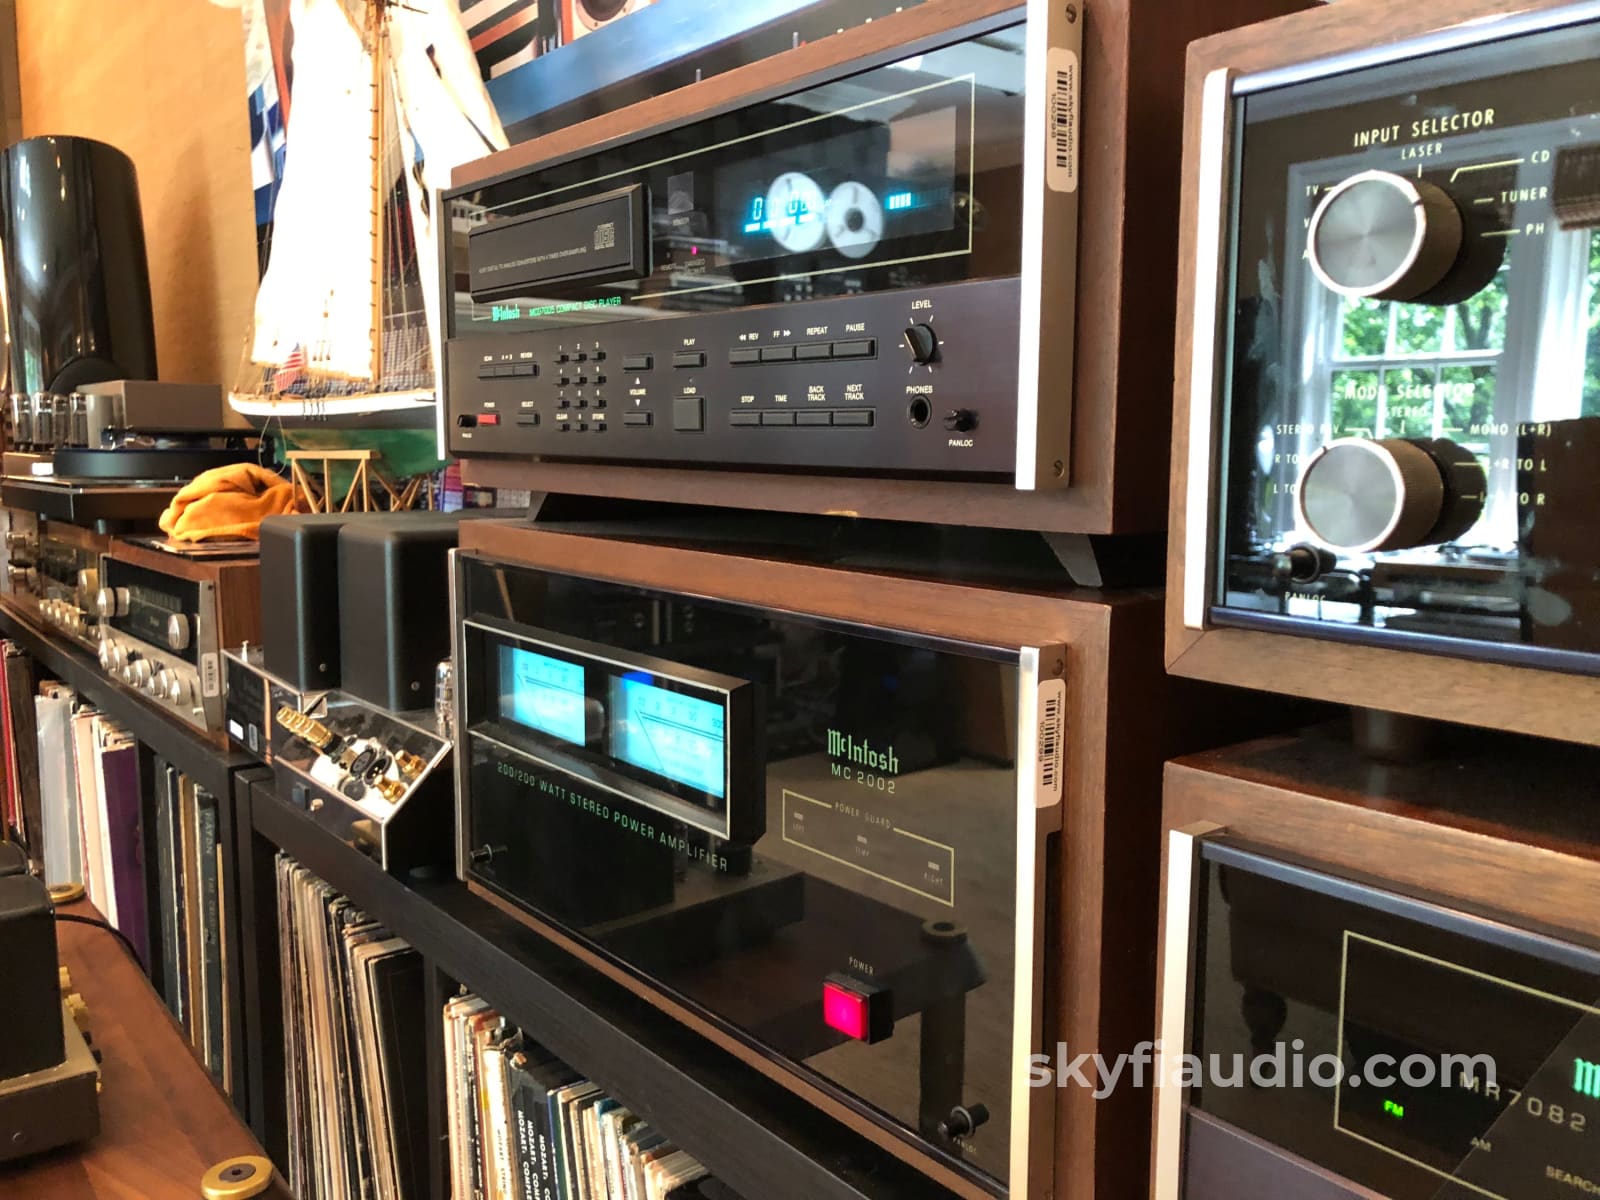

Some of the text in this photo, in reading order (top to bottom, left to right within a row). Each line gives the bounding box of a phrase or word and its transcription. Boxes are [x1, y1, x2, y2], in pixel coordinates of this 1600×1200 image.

[1354, 108, 1495, 148] INPUT SELECTOR
[1401, 143, 1442, 161] LASER
[1531, 150, 1549, 163] CD
[1305, 185, 1319, 197] TV
[1501, 186, 1548, 204] TUNER
[1526, 223, 1545, 236] PH
[556, 302, 582, 314] COMPACT
[583, 299, 597, 310] DISC
[599, 296, 621, 306] PLAYER
[911, 300, 932, 310] LEVEL
[773, 330, 780, 338] FF
[806, 326, 828, 336] REPEAT
[845, 323, 865, 333] PAUSE
[684, 338, 695, 346] PLAY
[748, 332, 759, 341] REV
[808, 385, 824, 393] BACK
[846, 384, 863, 392] NEXT
[906, 385, 933, 394] PHONES
[1344, 382, 1475, 401] MOD SELETOR
[741, 396, 754, 404] STOP
[807, 393, 826, 402] TRACK
[844, 392, 864, 401] TRACK
[1276, 424, 1314, 435] STERO
[1470, 423, 1552, 437] MONO (L+R)
[948, 439, 973, 448] PANLOC
[1517, 458, 1534, 471] TO
[1540, 459, 1547, 471] L
[1537, 492, 1545, 505] R
[827, 728, 899, 774] McIntosh
[831, 762, 896, 794] MC 2002
[497, 761, 728, 872] 200/200 WATT STEREO POWER AMPLIFIER
[848, 956, 874, 977] POWER
[1384, 1100, 1404, 1117] FM
[1470, 1136, 1492, 1152] AM
